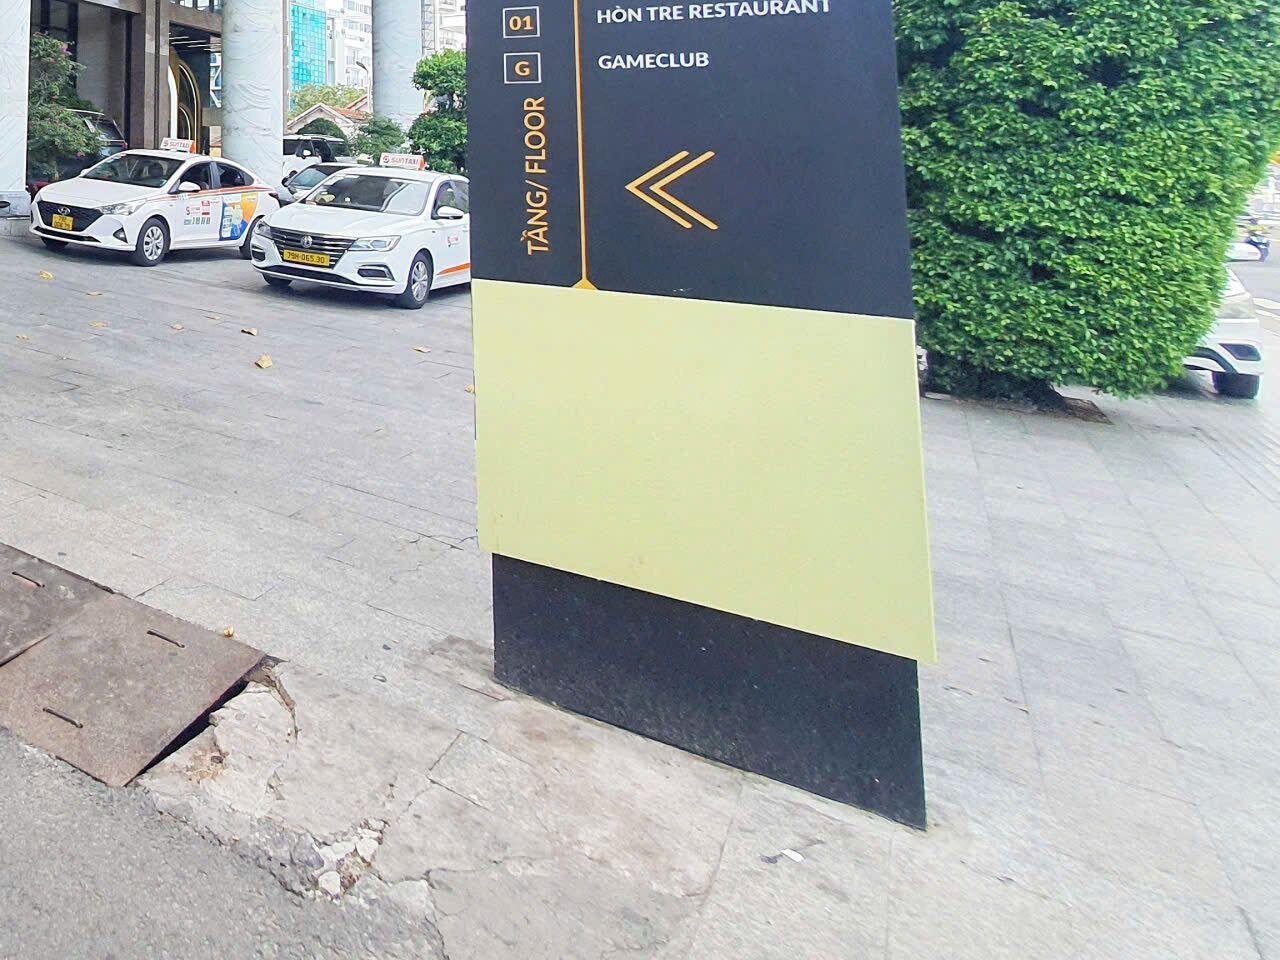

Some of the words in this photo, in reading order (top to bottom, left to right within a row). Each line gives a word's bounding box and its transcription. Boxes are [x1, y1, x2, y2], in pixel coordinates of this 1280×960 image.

[509, 15, 534, 32] 01
[596, 5, 642, 24] HÒN
[645, 4, 685, 22] TRE
[514, 60, 532, 77] G
[597, 51, 710, 70] GAMECLUB
[523, 96, 547, 174] FLOOR
